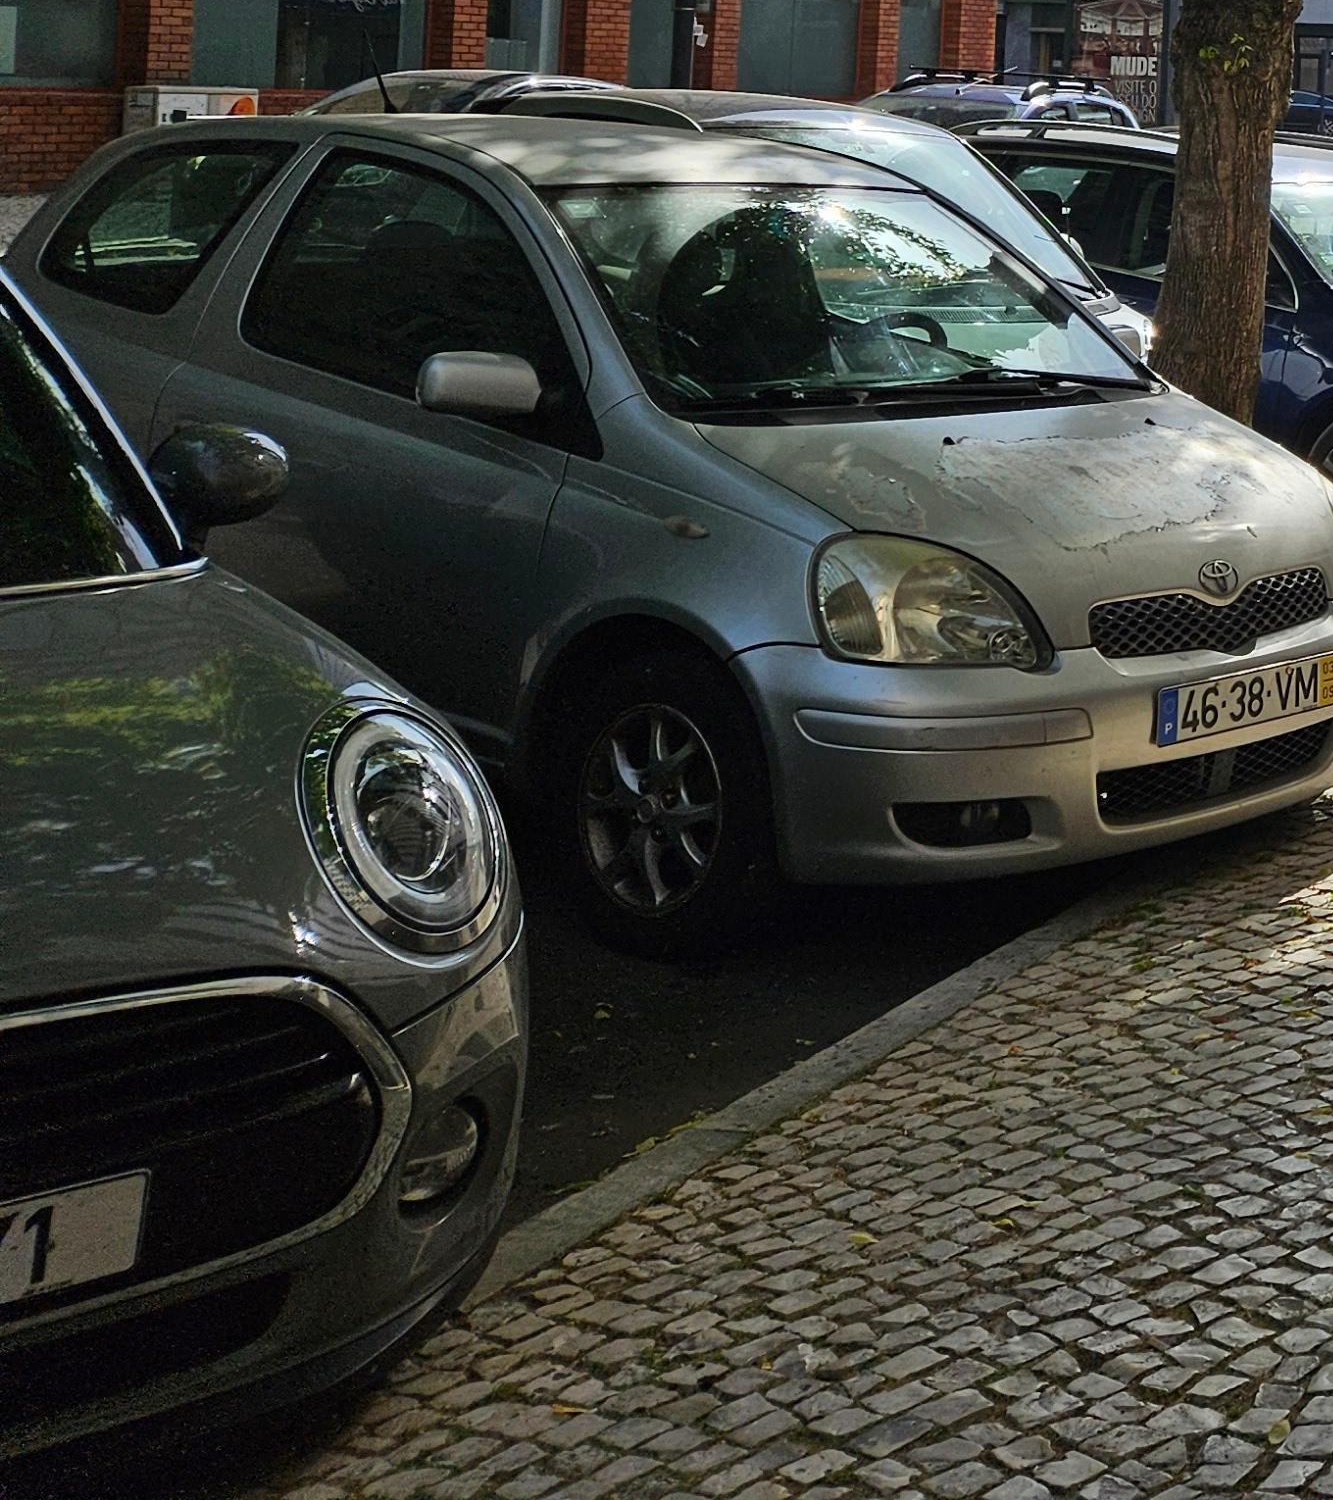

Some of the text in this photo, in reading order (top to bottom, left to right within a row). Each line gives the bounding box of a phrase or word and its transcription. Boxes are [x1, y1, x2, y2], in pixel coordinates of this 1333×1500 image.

[1110, 56, 1157, 76] MUDE
[1148, 79, 1157, 94] O
[1164, 723, 1173, 736] P
